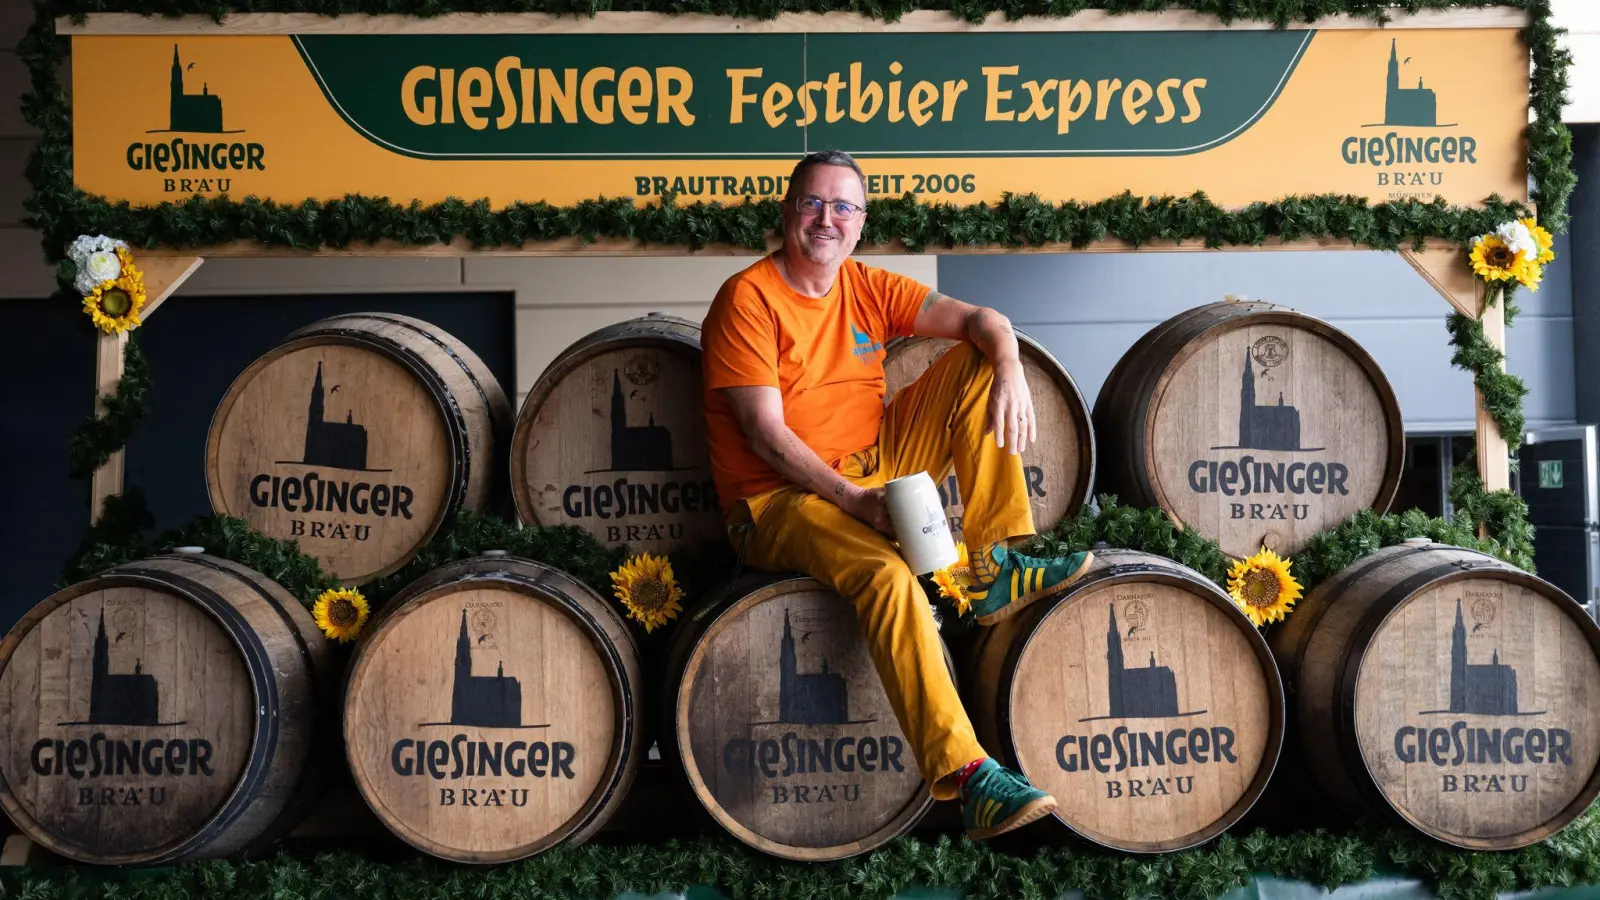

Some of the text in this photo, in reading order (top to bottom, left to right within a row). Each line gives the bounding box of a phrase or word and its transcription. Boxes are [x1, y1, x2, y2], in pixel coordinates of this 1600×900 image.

[725, 60, 969, 129] Festbier
[980, 64, 1208, 136] Express
[163, 178, 232, 193] BRÄU
[866, 174, 906, 194] EIT
[912, 173, 977, 195] 2006
[1376, 171, 1444, 186] BRÄU
[1230, 502, 1310, 521] BRÄU
[290, 519, 372, 542] BRÄU
[1105, 775, 1195, 799] BRÄU
[1442, 773, 1529, 794] BRÄU
[439, 787, 531, 807] BRÄU
